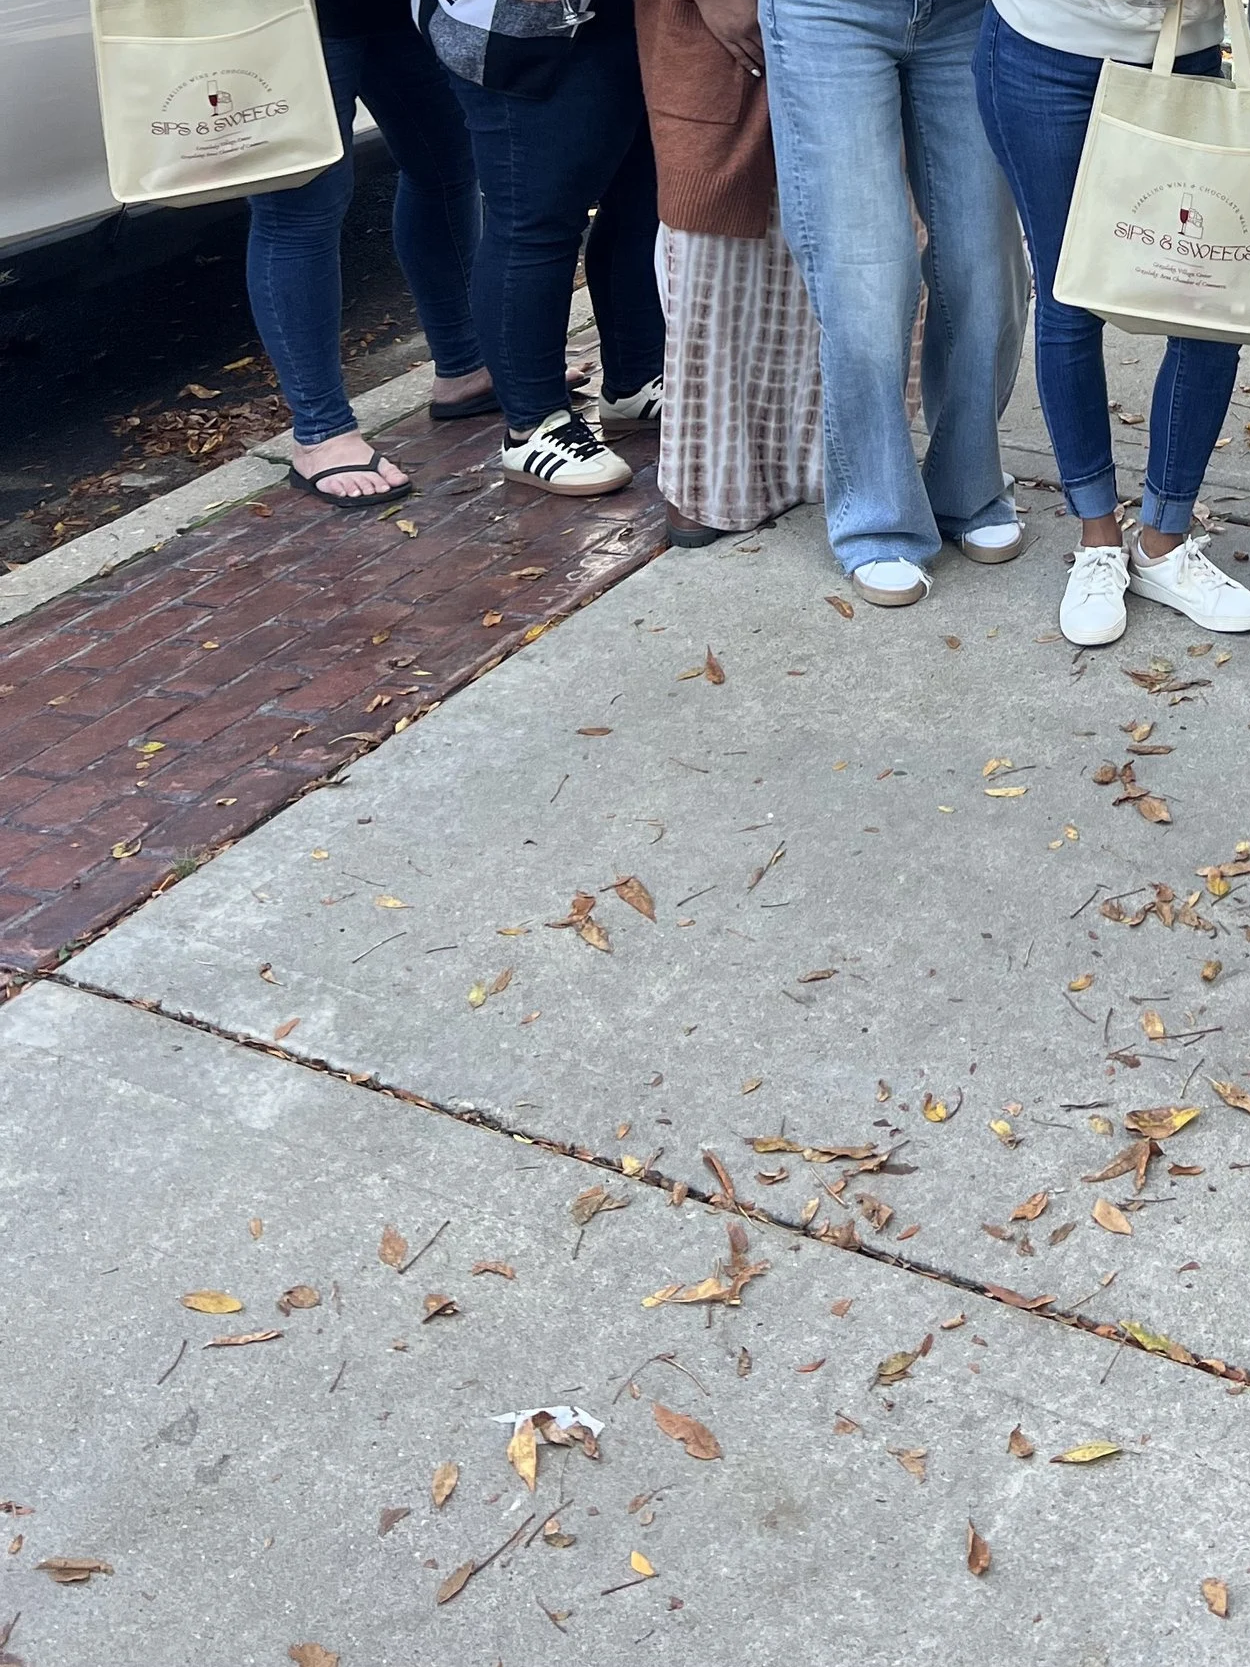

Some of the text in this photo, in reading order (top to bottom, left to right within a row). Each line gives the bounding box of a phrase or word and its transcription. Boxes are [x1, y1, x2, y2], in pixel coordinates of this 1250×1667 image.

[151, 99, 289, 136] SIPS & SWEETS
[1114, 221, 1155, 245] SIPS
[1159, 234, 1172, 251] &
